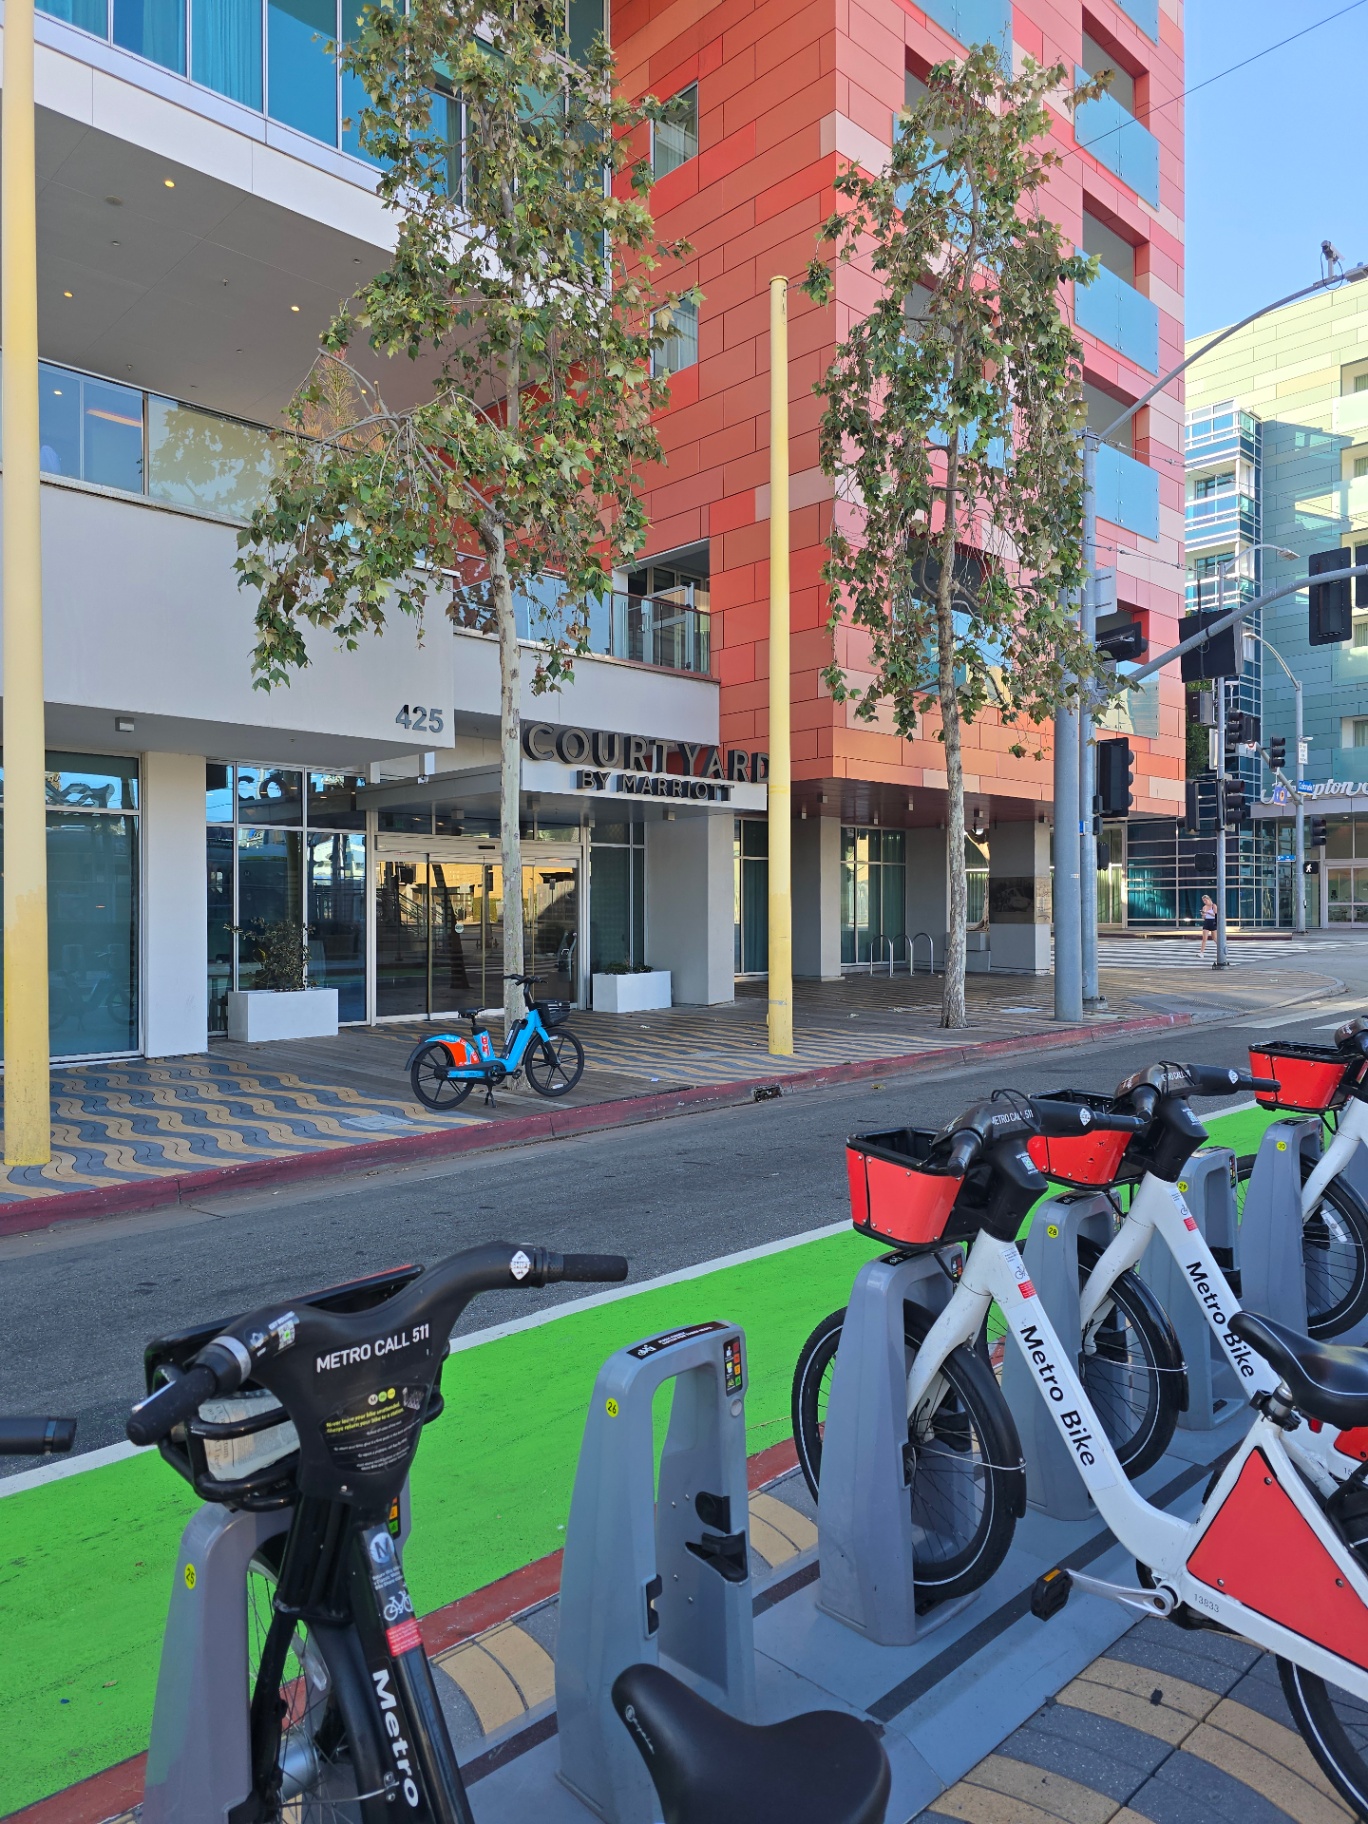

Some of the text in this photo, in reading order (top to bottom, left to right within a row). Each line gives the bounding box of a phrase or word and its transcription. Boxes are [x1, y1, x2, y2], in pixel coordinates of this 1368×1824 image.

[395, 704, 444, 733] 425
[522, 721, 770, 784] COURTYARD
[576, 769, 735, 802] BY MARRIOTT
[1026, 1109, 1035, 1119] 511
[1185, 1260, 1226, 1326] Metro
[1222, 1332, 1255, 1378] Bike
[316, 1323, 430, 1374] METRO CALL 511
[607, 1401, 617, 1415] 26
[1019, 1324, 1064, 1402] Metro
[1060, 1409, 1096, 1467] Bike
[374, 1537, 391, 1559] M
[186, 1567, 195, 1585] 25
[1194, 1593, 1220, 1613] 13833
[372, 1668, 419, 1808] Metro
